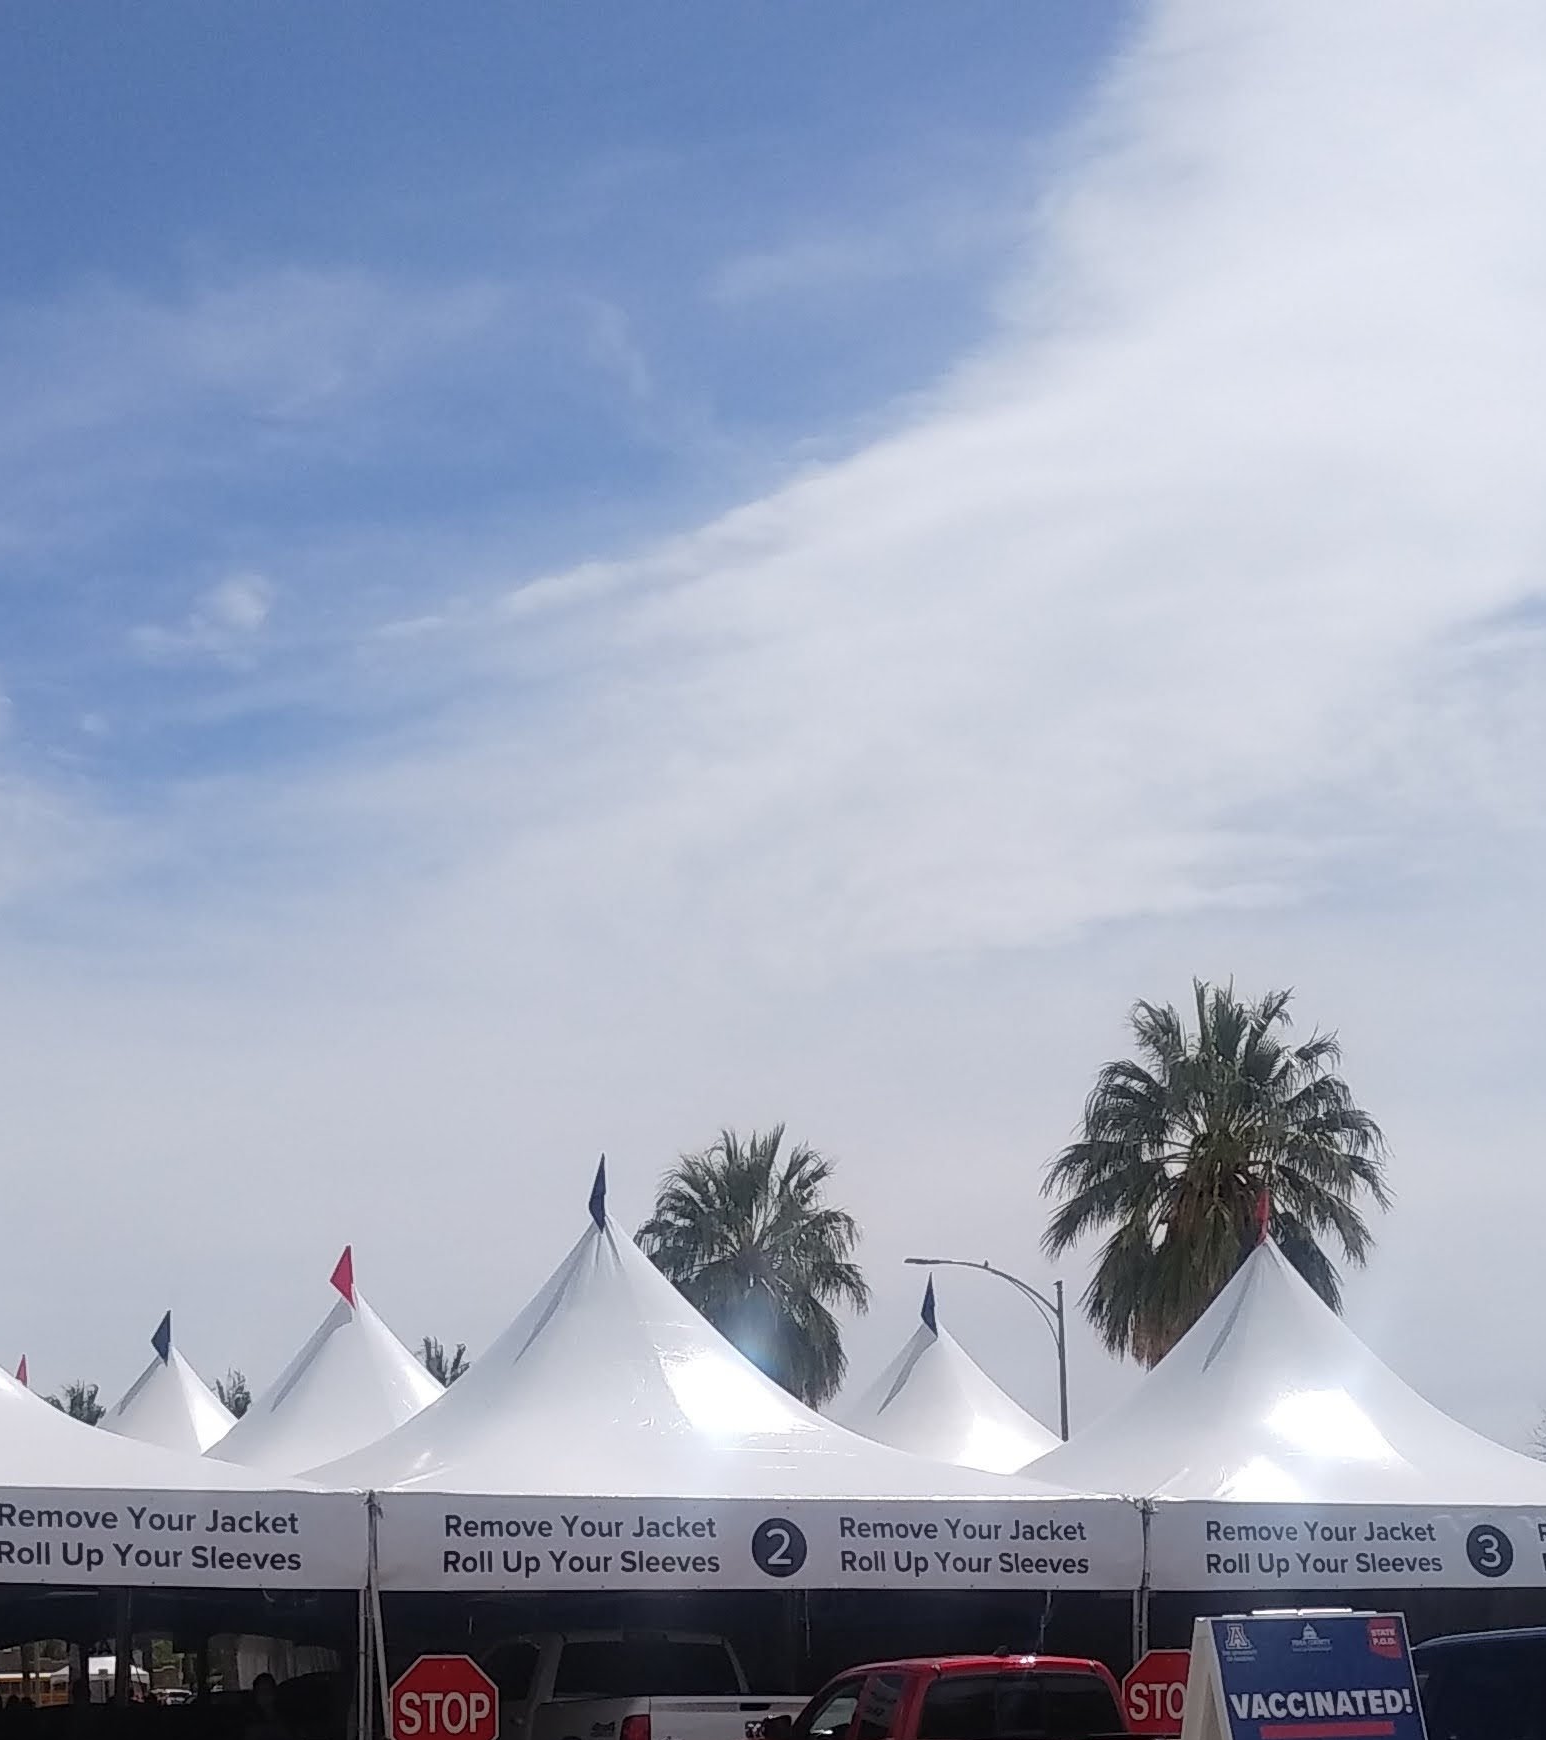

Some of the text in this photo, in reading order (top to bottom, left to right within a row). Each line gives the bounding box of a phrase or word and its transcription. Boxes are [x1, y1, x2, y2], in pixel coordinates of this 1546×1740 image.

[127, 1507, 196, 1531] Your
[206, 1510, 298, 1534] Jacket
[445, 1515, 716, 1537] Remove Your Jacket
[840, 1517, 1086, 1540] Remove Your Jacket
[1207, 1521, 1436, 1541] Remove Your Jacket
[62, 1543, 103, 1571] Up
[113, 1543, 182, 1567] Your
[192, 1546, 301, 1570] Sleeves
[765, 1527, 792, 1565] 2
[1477, 1535, 1501, 1568] 3
[444, 1551, 719, 1578] Roll Up Your Sleeves
[841, 1551, 1088, 1577] Roll Up Your Sleeves
[1207, 1553, 1442, 1578] Roll Up Your Sleeves
[398, 1692, 491, 1735] STOP
[1129, 1682, 1186, 1720] STO
[1229, 1689, 1413, 1719] VACCINATED!
